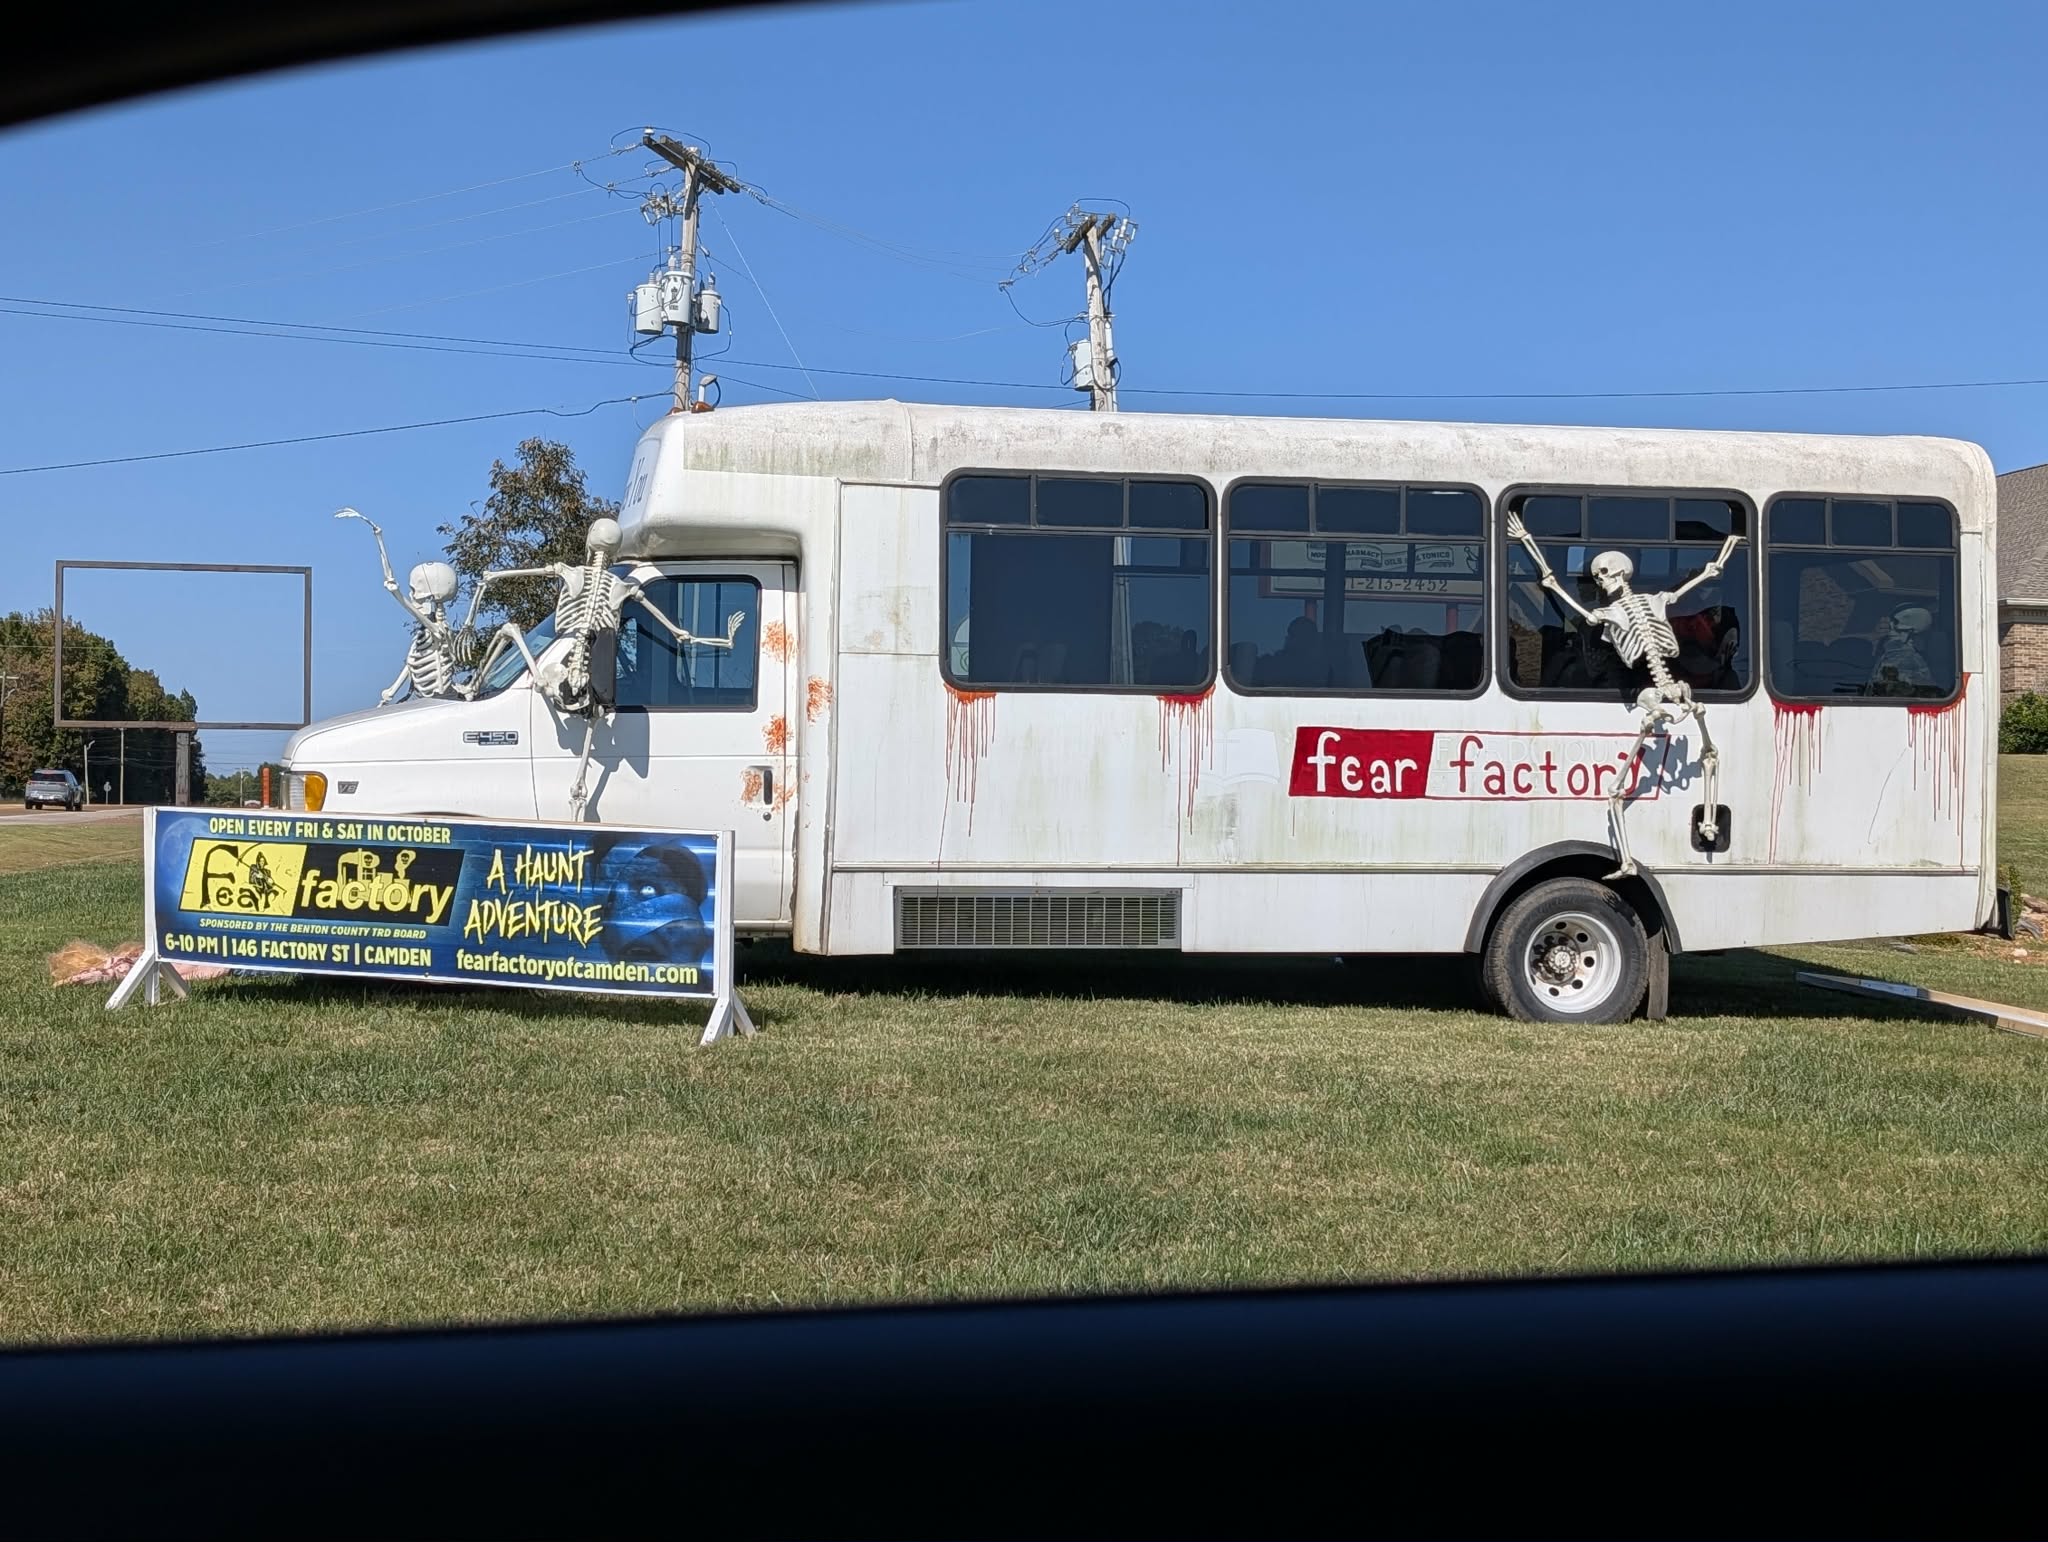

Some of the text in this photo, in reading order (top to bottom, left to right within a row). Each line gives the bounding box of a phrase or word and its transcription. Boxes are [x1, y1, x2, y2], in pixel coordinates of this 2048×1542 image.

[1307, 730, 1418, 793] fear
[209, 817, 450, 844] OPEN EVERY FRI & SAT IN OCTOBER
[200, 844, 454, 923] Fear factory
[487, 839, 594, 895] A HAUNT
[200, 918, 427, 940] SPONSORED BY THE BENTON COUNTY TRD BOARD
[463, 889, 603, 948] ADVENTURE
[165, 933, 193, 952] 6-10
[198, 935, 218, 954] PM
[231, 938, 257, 957] 146
[261, 940, 329, 961] FACTORY
[332, 943, 350, 962] ST
[364, 945, 432, 967] CAMDEN
[456, 948, 698, 985] fearfactoryofcamden.com
